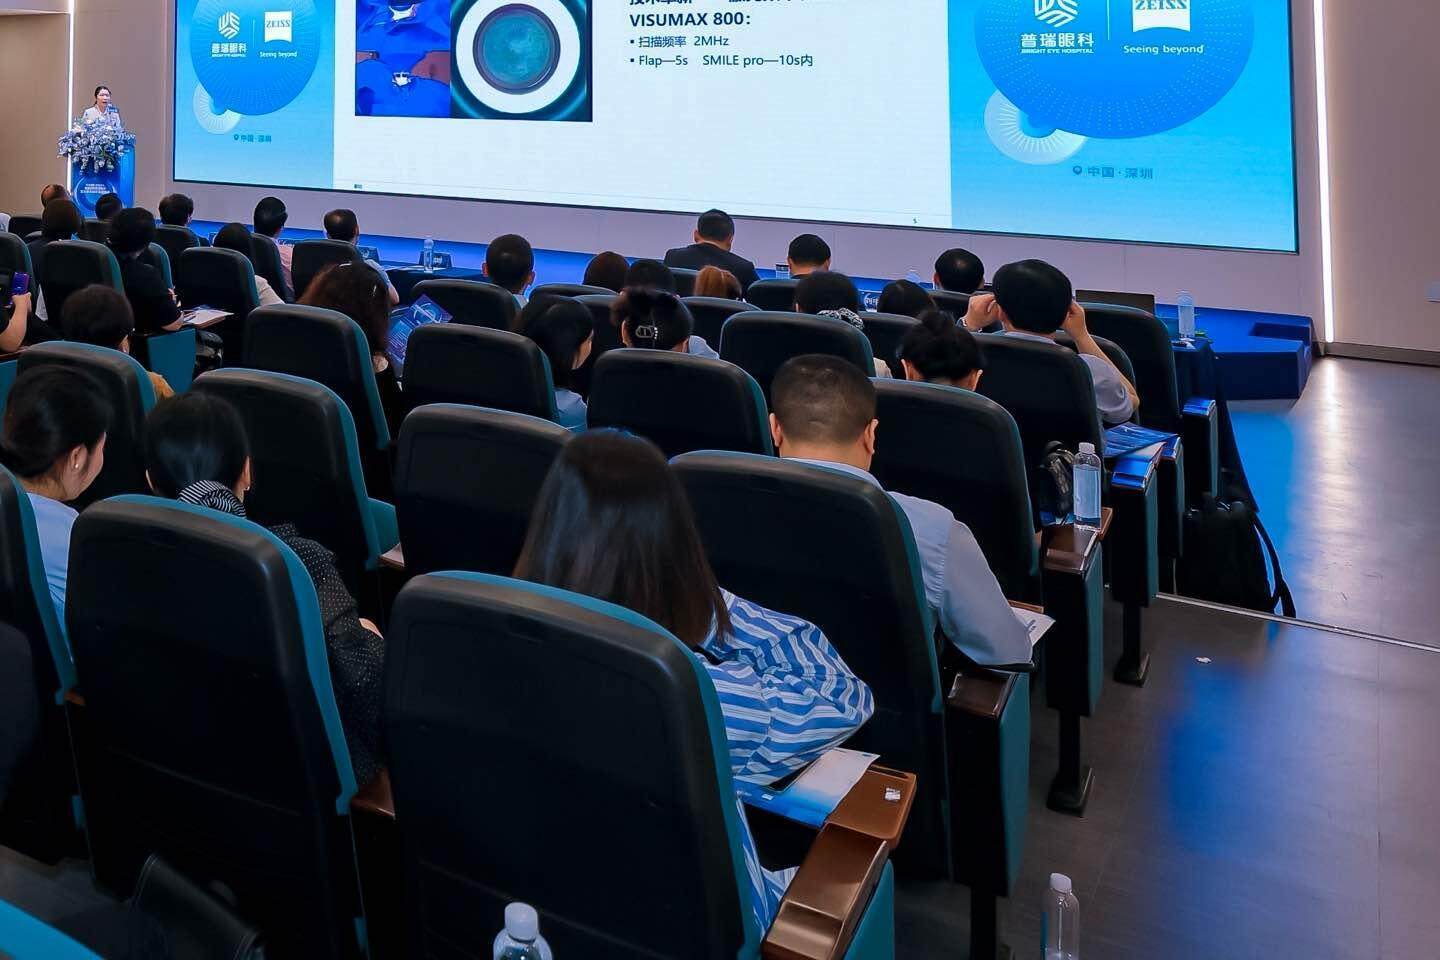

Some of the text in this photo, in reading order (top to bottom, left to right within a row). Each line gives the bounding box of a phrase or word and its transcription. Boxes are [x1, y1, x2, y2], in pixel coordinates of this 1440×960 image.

[1135, 0, 1188, 11] ZEISS
[266, 19, 291, 29] ZEISS
[629, 12, 708, 27] VISUMAX
[638, 35, 730, 48] 扫描频率 2MHz
[1020, 32, 1094, 48] 普瑞眼科
[1123, 44, 1204, 56] Seeing beyond
[702, 54, 739, 66] SMILE
